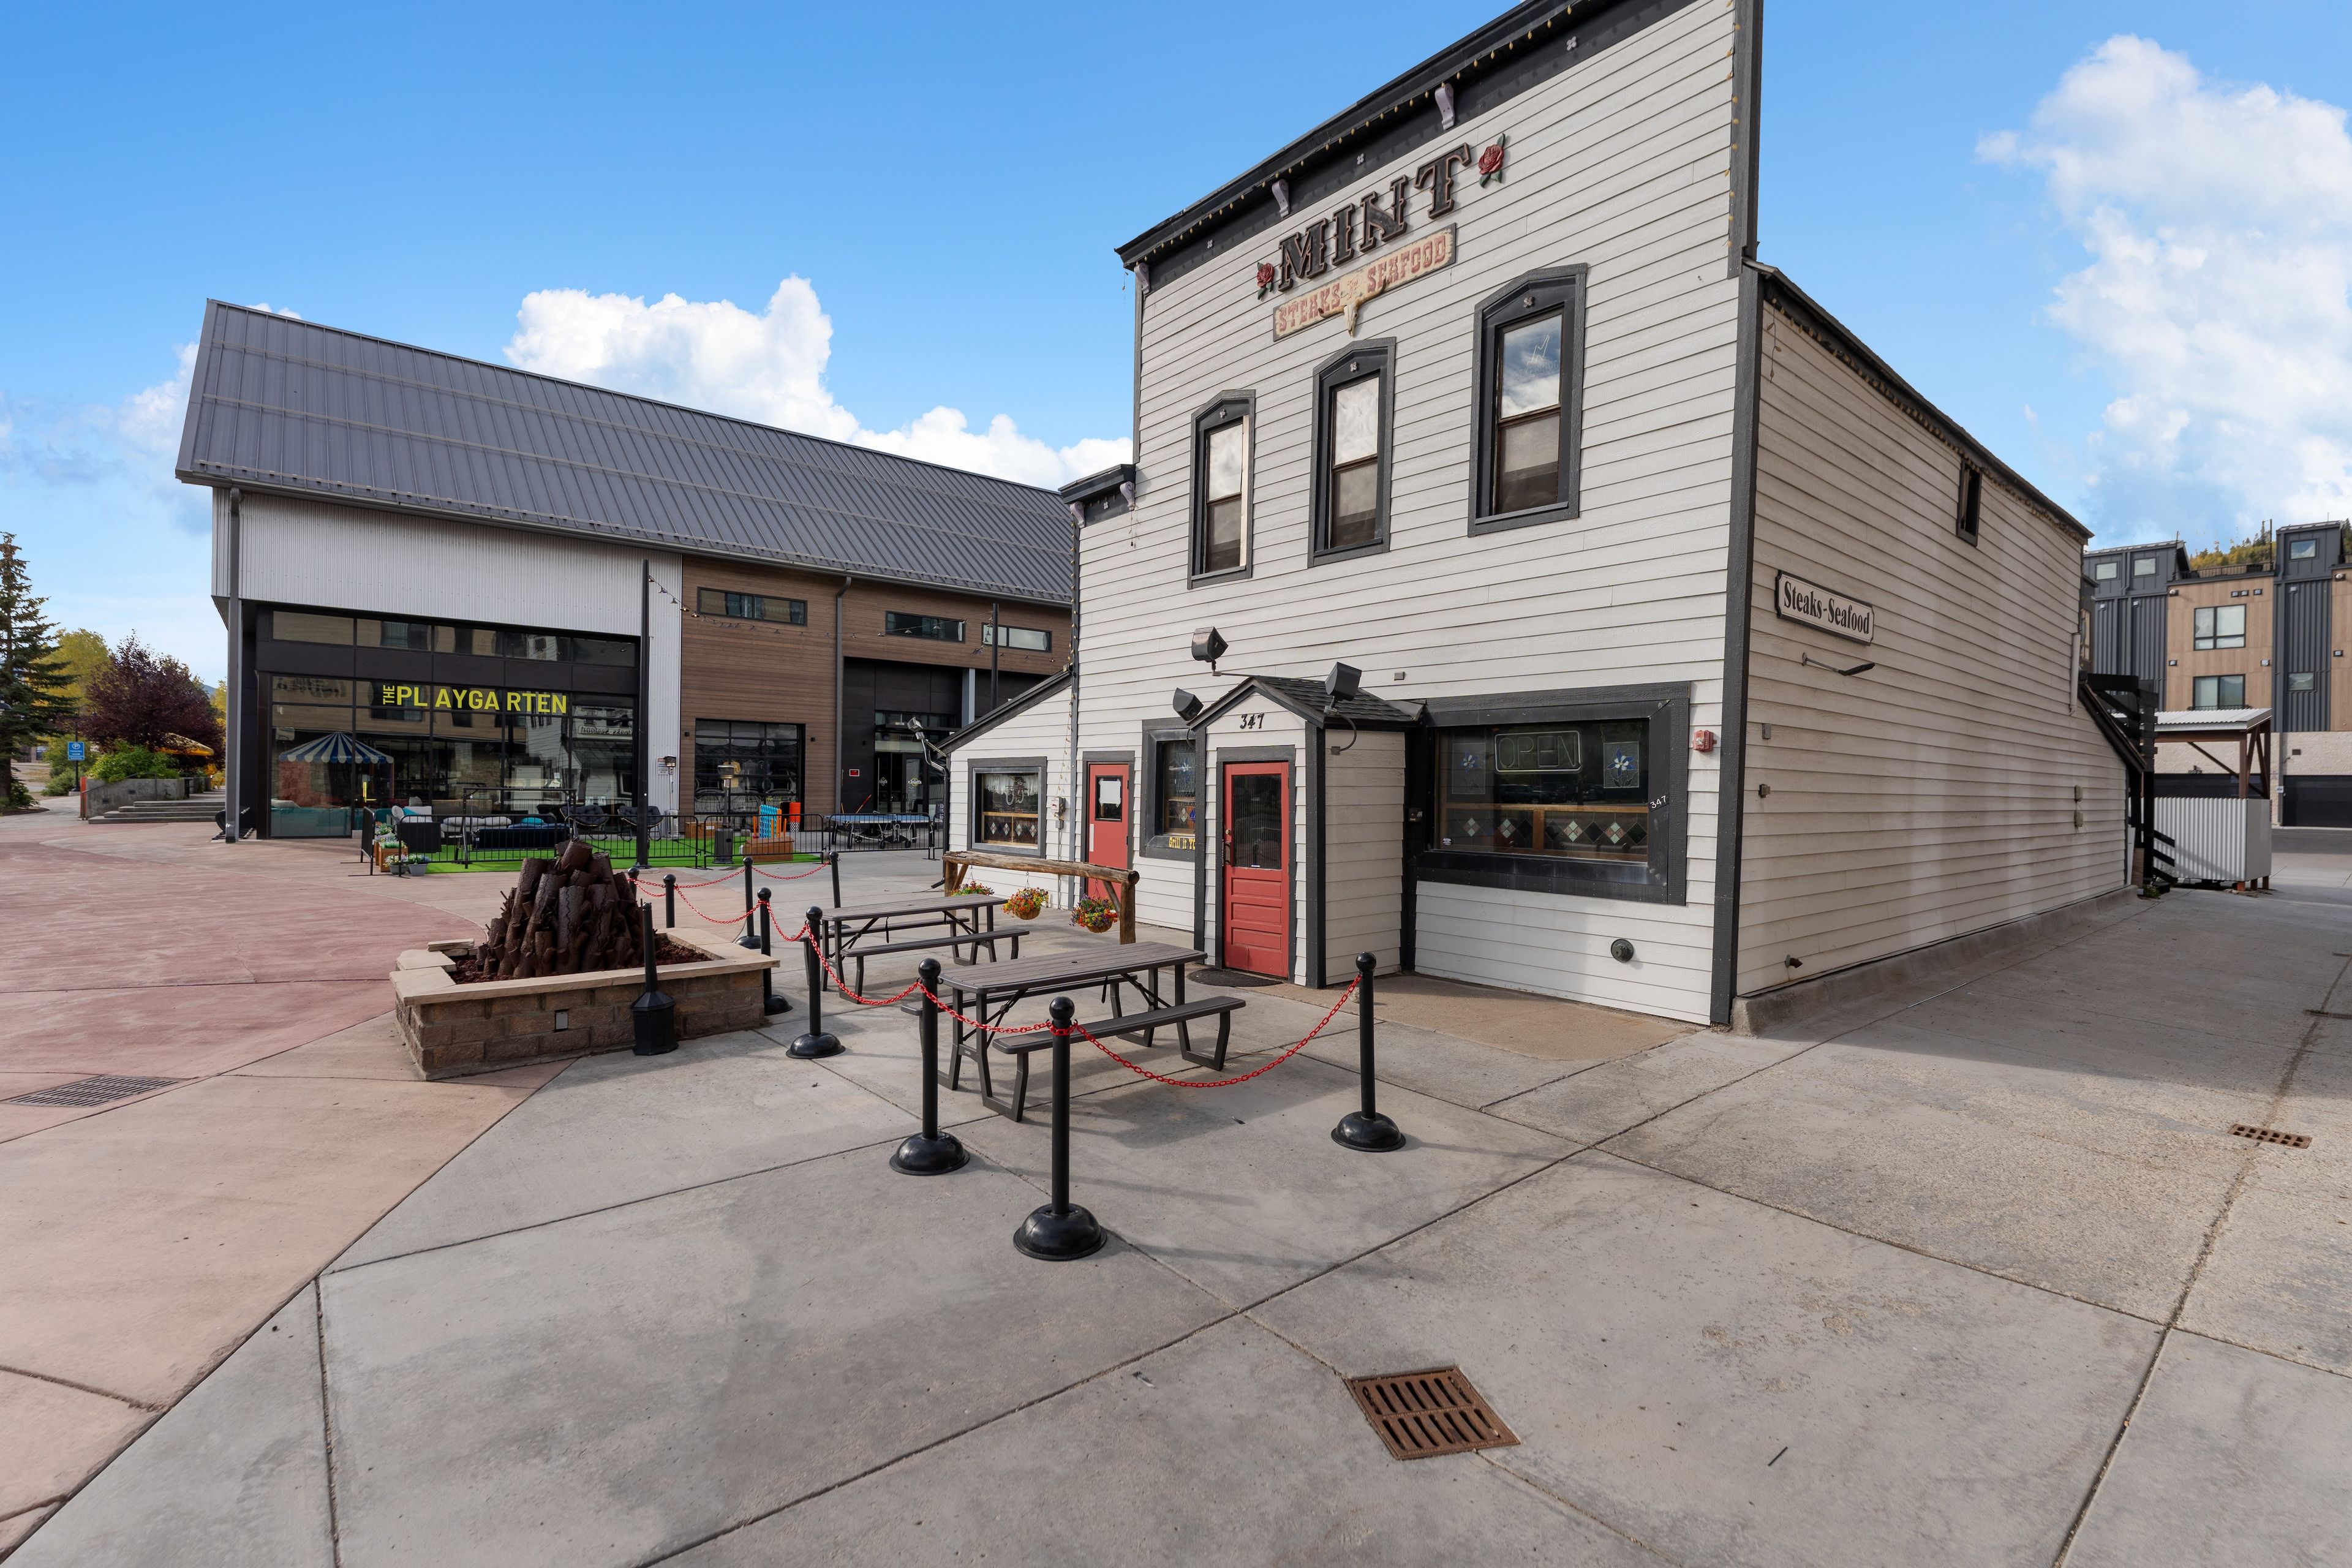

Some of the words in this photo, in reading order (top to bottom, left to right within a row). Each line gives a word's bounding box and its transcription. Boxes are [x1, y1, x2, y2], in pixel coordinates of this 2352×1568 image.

[1278, 142, 1472, 292] MINT
[1278, 282, 1341, 332] STEAKS
[1366, 235, 1446, 293] SEAFOOD
[382, 684, 395, 705] THE
[1239, 713, 1265, 729] 347
[1498, 736, 1576, 769] OPEN
[1650, 795, 1667, 809] 347
[1169, 836, 1180, 849] Grill
[1182, 838, 1187, 850] it
